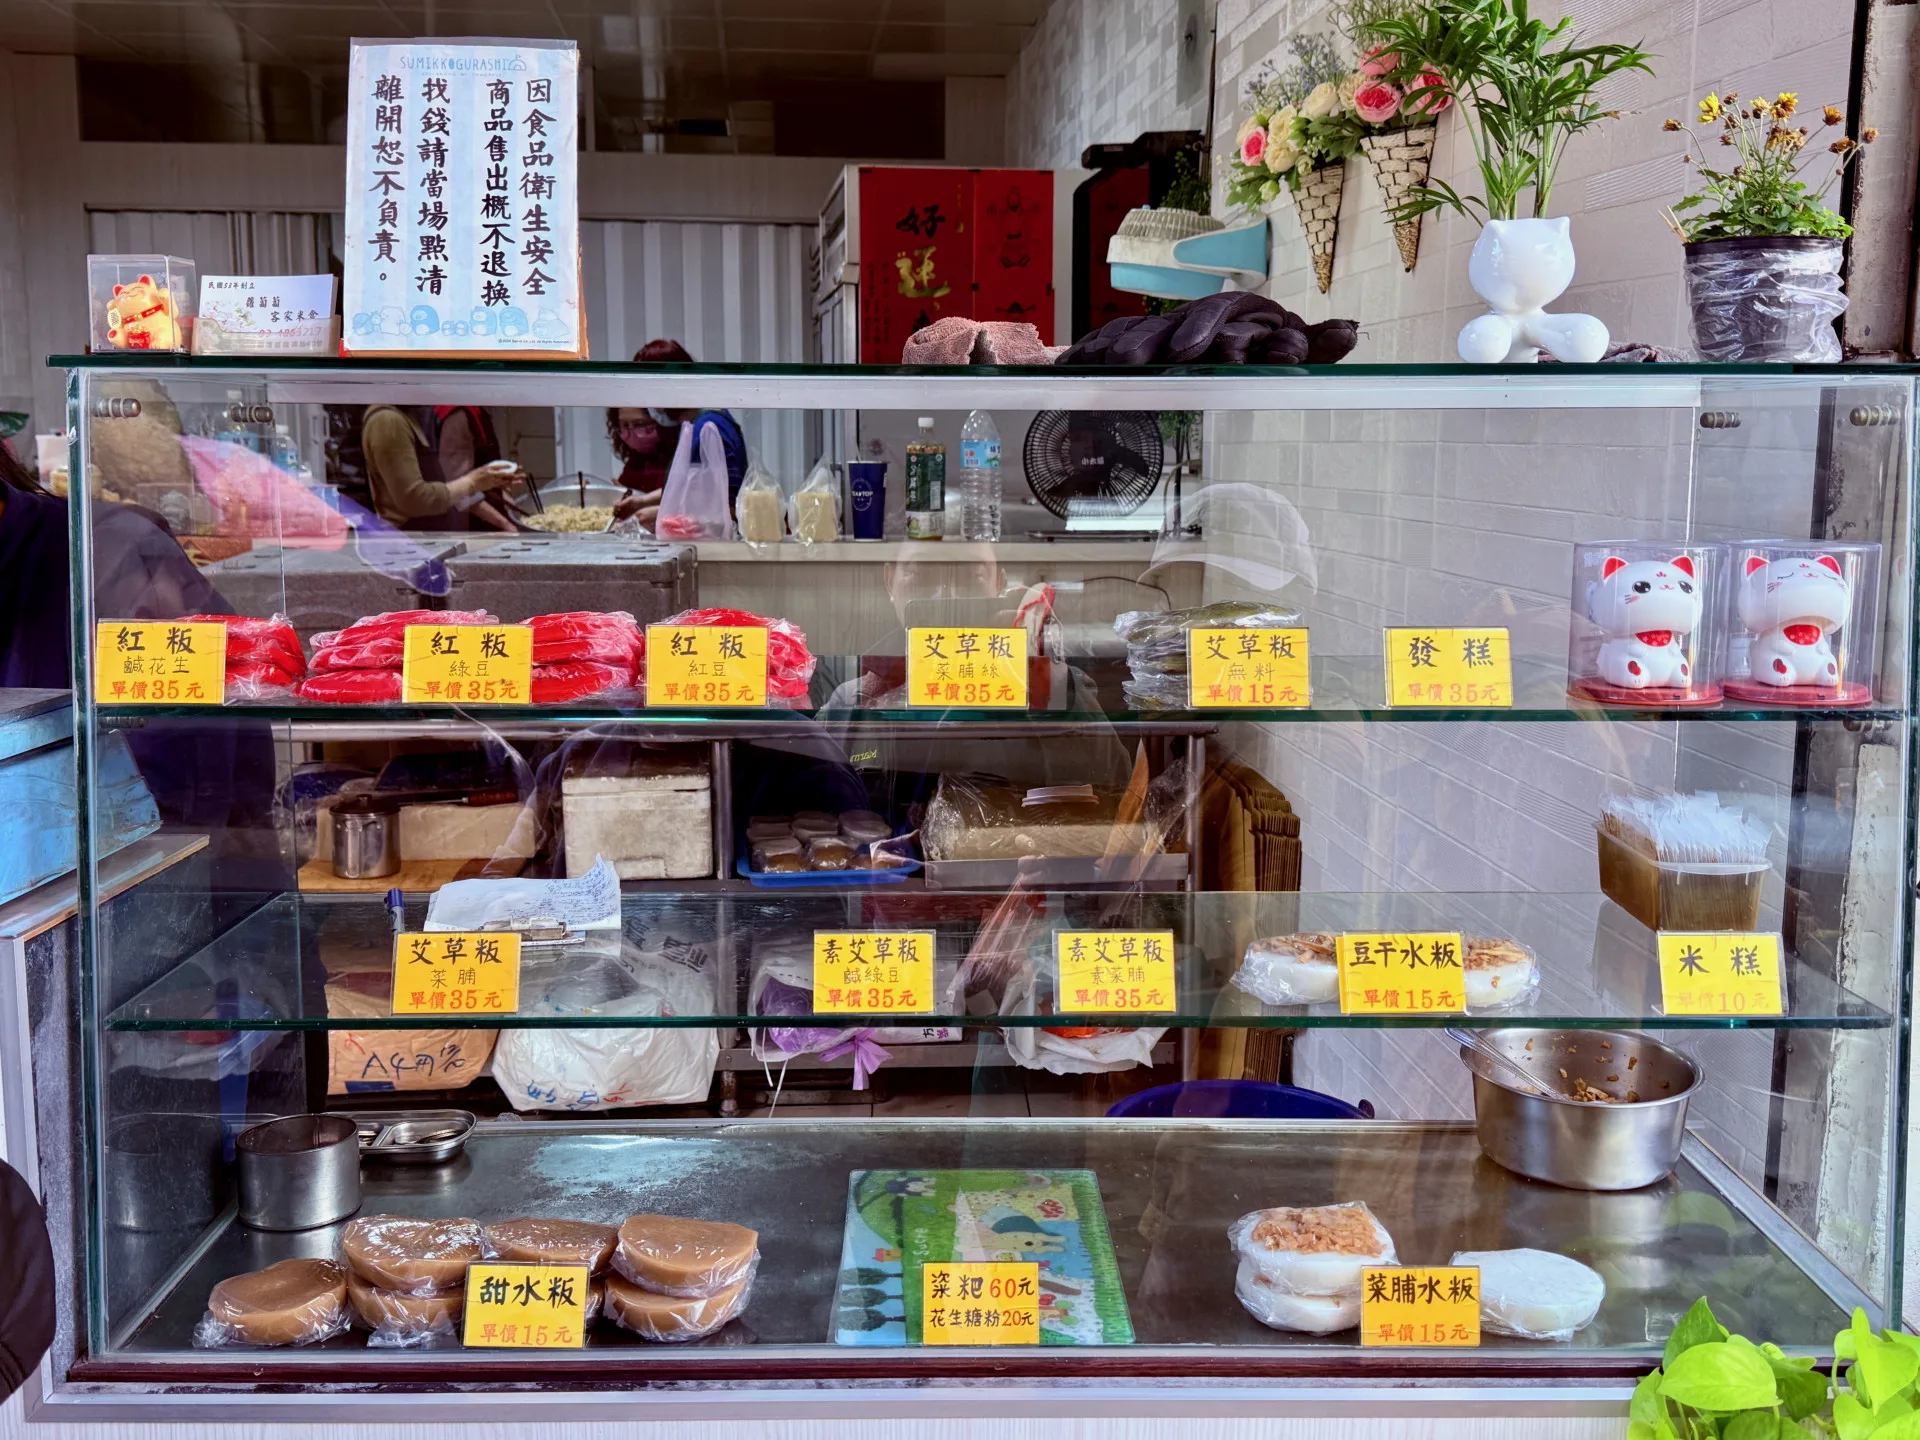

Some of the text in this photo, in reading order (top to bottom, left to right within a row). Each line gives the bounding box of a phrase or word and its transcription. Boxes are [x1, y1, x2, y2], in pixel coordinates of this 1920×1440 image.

[367, 73, 405, 282] 離開恕不負責。
[414, 77, 452, 297] 找錢請當場點清
[518, 77, 558, 296] 因食品衛生安全
[478, 78, 516, 308] 商品售出概不退換
[116, 626, 196, 655] 紅粄
[430, 631, 510, 659] 紅粄
[670, 631, 747, 660] 紅粄
[923, 632, 1015, 660] 艾草粄
[1206, 633, 1296, 660] 艾草粄
[1408, 635, 1494, 669] 發糕
[688, 659, 726, 677] 紅豆
[936, 661, 1000, 681] 菜脯絲
[1228, 662, 1276, 682] 無料
[110, 679, 205, 700] 單價35元
[424, 680, 519, 701] 單價35元
[663, 682, 755, 702] 單價35元
[924, 682, 1015, 703] 單價35元
[1206, 683, 1298, 704] 單價15元
[1408, 682, 1500, 703] 單價35元
[408, 937, 503, 965] 艾草粄
[822, 936, 920, 965] 素艾草粄
[1067, 936, 1165, 964] 素艾草粄
[1349, 939, 1463, 970] 豆干水粄
[1678, 944, 1762, 977] 米糕
[430, 967, 476, 989] 菜脯
[408, 989, 502, 1010] 單價35元
[826, 987, 917, 1008] 單價35元
[1074, 987, 1164, 1009] 單價35元
[1363, 988, 1456, 1010] 單價15元
[1676, 989, 1769, 1013] 單價10元
[479, 1274, 578, 1309] 甜水粄
[1365, 1272, 1479, 1305] 菜脯水粄
[929, 1307, 1035, 1328] 花生糖粉20元
[480, 1323, 573, 1346] 單價15元
[1378, 1323, 1470, 1343] 單價15元
